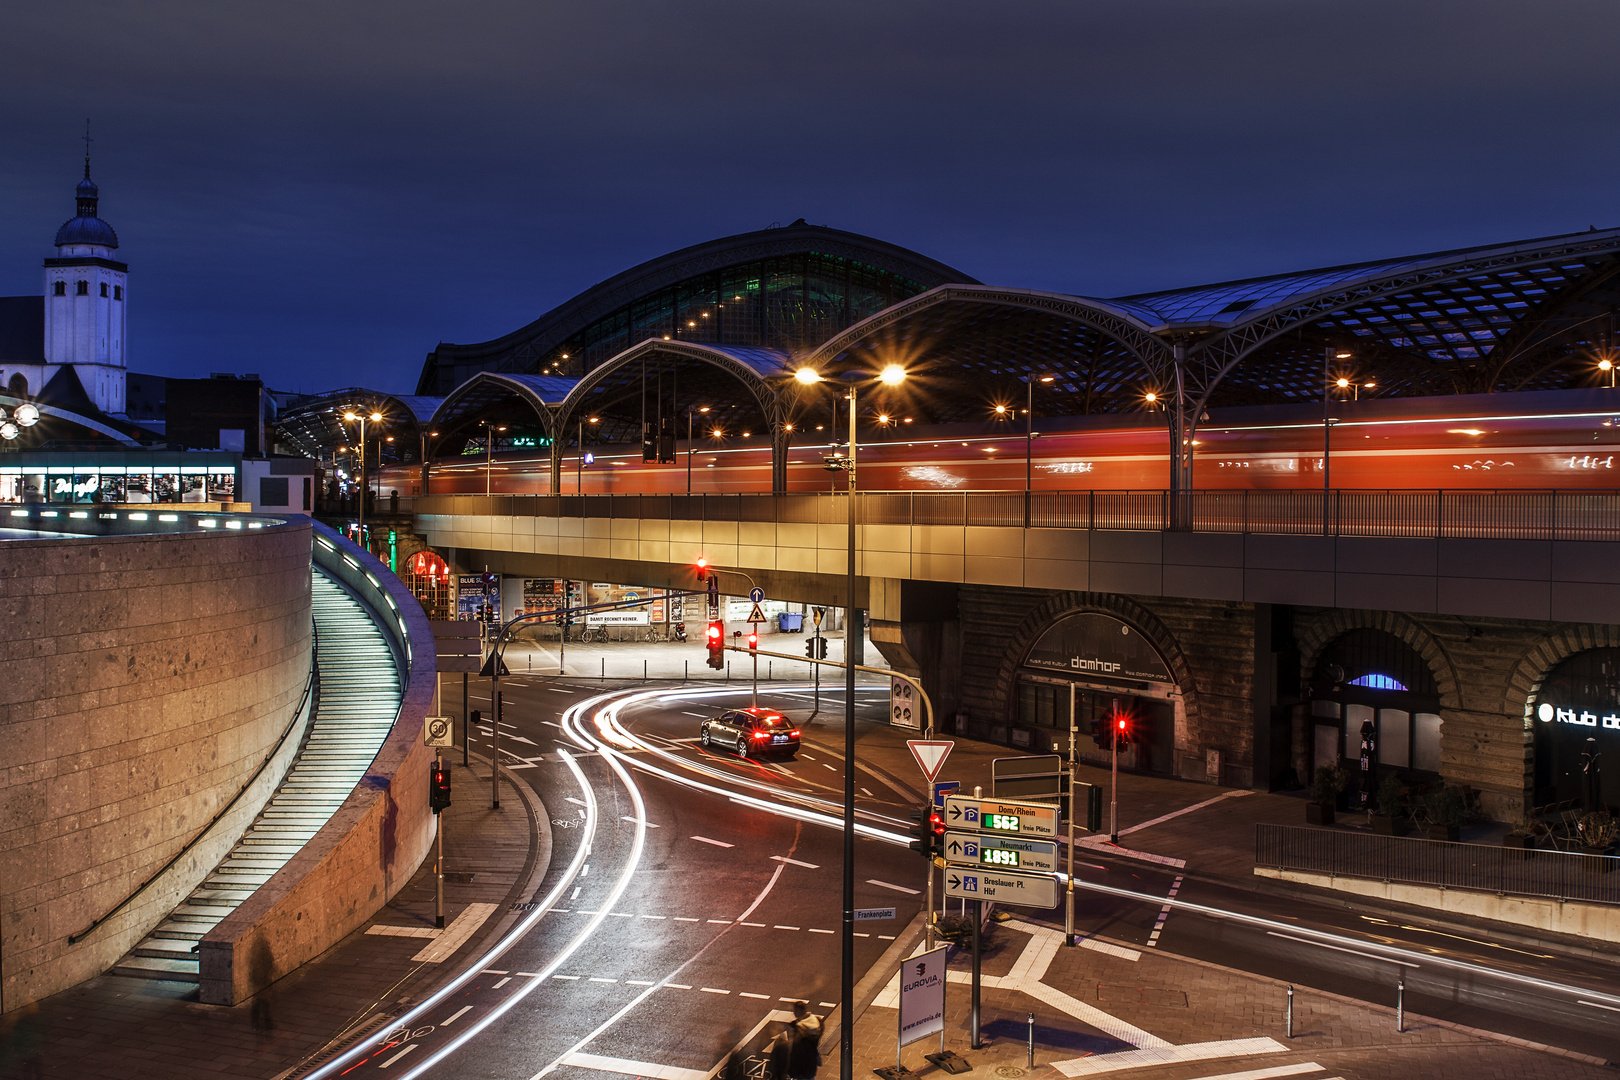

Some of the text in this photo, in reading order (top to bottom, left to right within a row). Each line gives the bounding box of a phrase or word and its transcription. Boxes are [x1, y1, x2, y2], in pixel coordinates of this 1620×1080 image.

[1556, 707, 1597, 727] klub
[433, 724, 444, 733] 30
[998, 805, 1036, 817] Dom/Rhein
[993, 814, 1019, 831] 562
[1022, 824, 1051, 833] freie Plätze
[1000, 841, 1033, 852] Neumarkt
[984, 849, 1018, 866] 1891
[1035, 860, 1051, 869] Plätze
[984, 877, 1025, 889] Breslauer Pl.
[984, 888, 996, 896] Hbf
[857, 909, 893, 919] Frankenplatz
[903, 974, 938, 993] EUROVIA
[902, 1011, 942, 1032] www.eurovia.de
